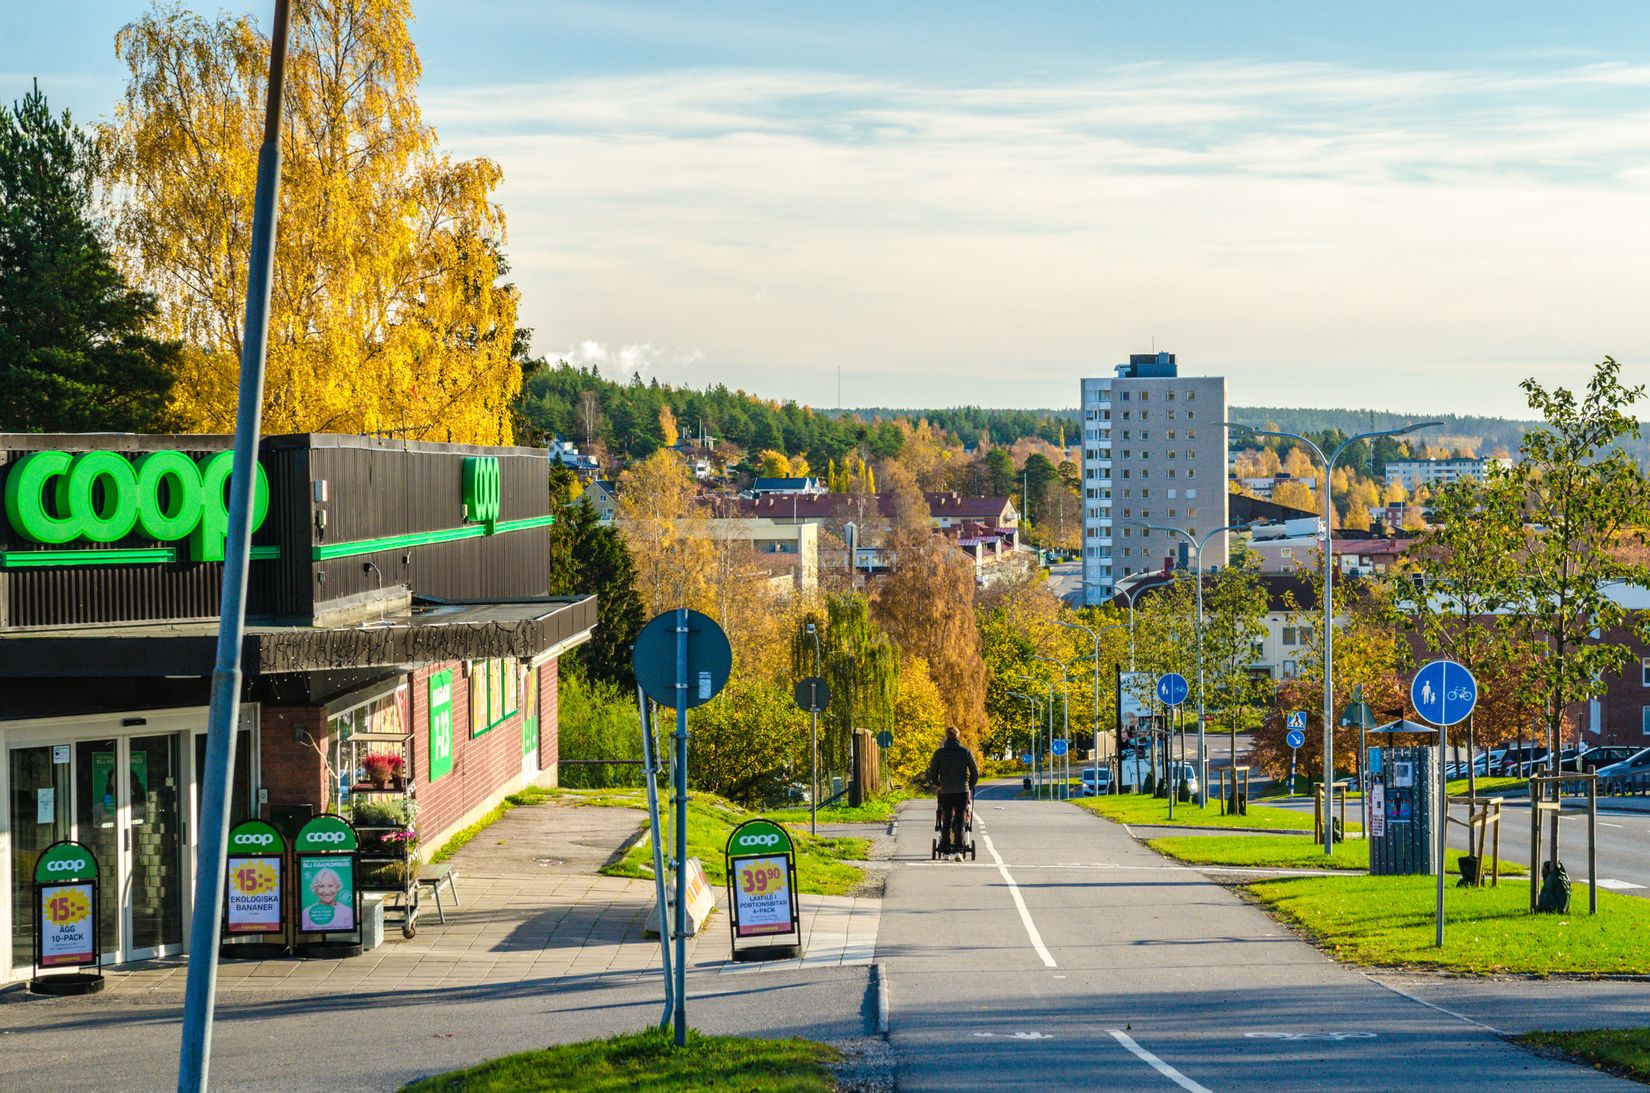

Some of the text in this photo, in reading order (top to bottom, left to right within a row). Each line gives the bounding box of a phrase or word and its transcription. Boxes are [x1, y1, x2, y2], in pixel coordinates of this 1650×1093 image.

[470, 456, 500, 535] coop
[6, 450, 269, 562] coop
[234, 833, 273, 846] coop
[306, 831, 346, 844] coop
[739, 833, 779, 846] coop
[47, 859, 86, 872] coop
[230, 895, 279, 903] EKOLOGISKA
[236, 903, 273, 911] BANANER
[51, 933, 84, 942] 10-PACK
